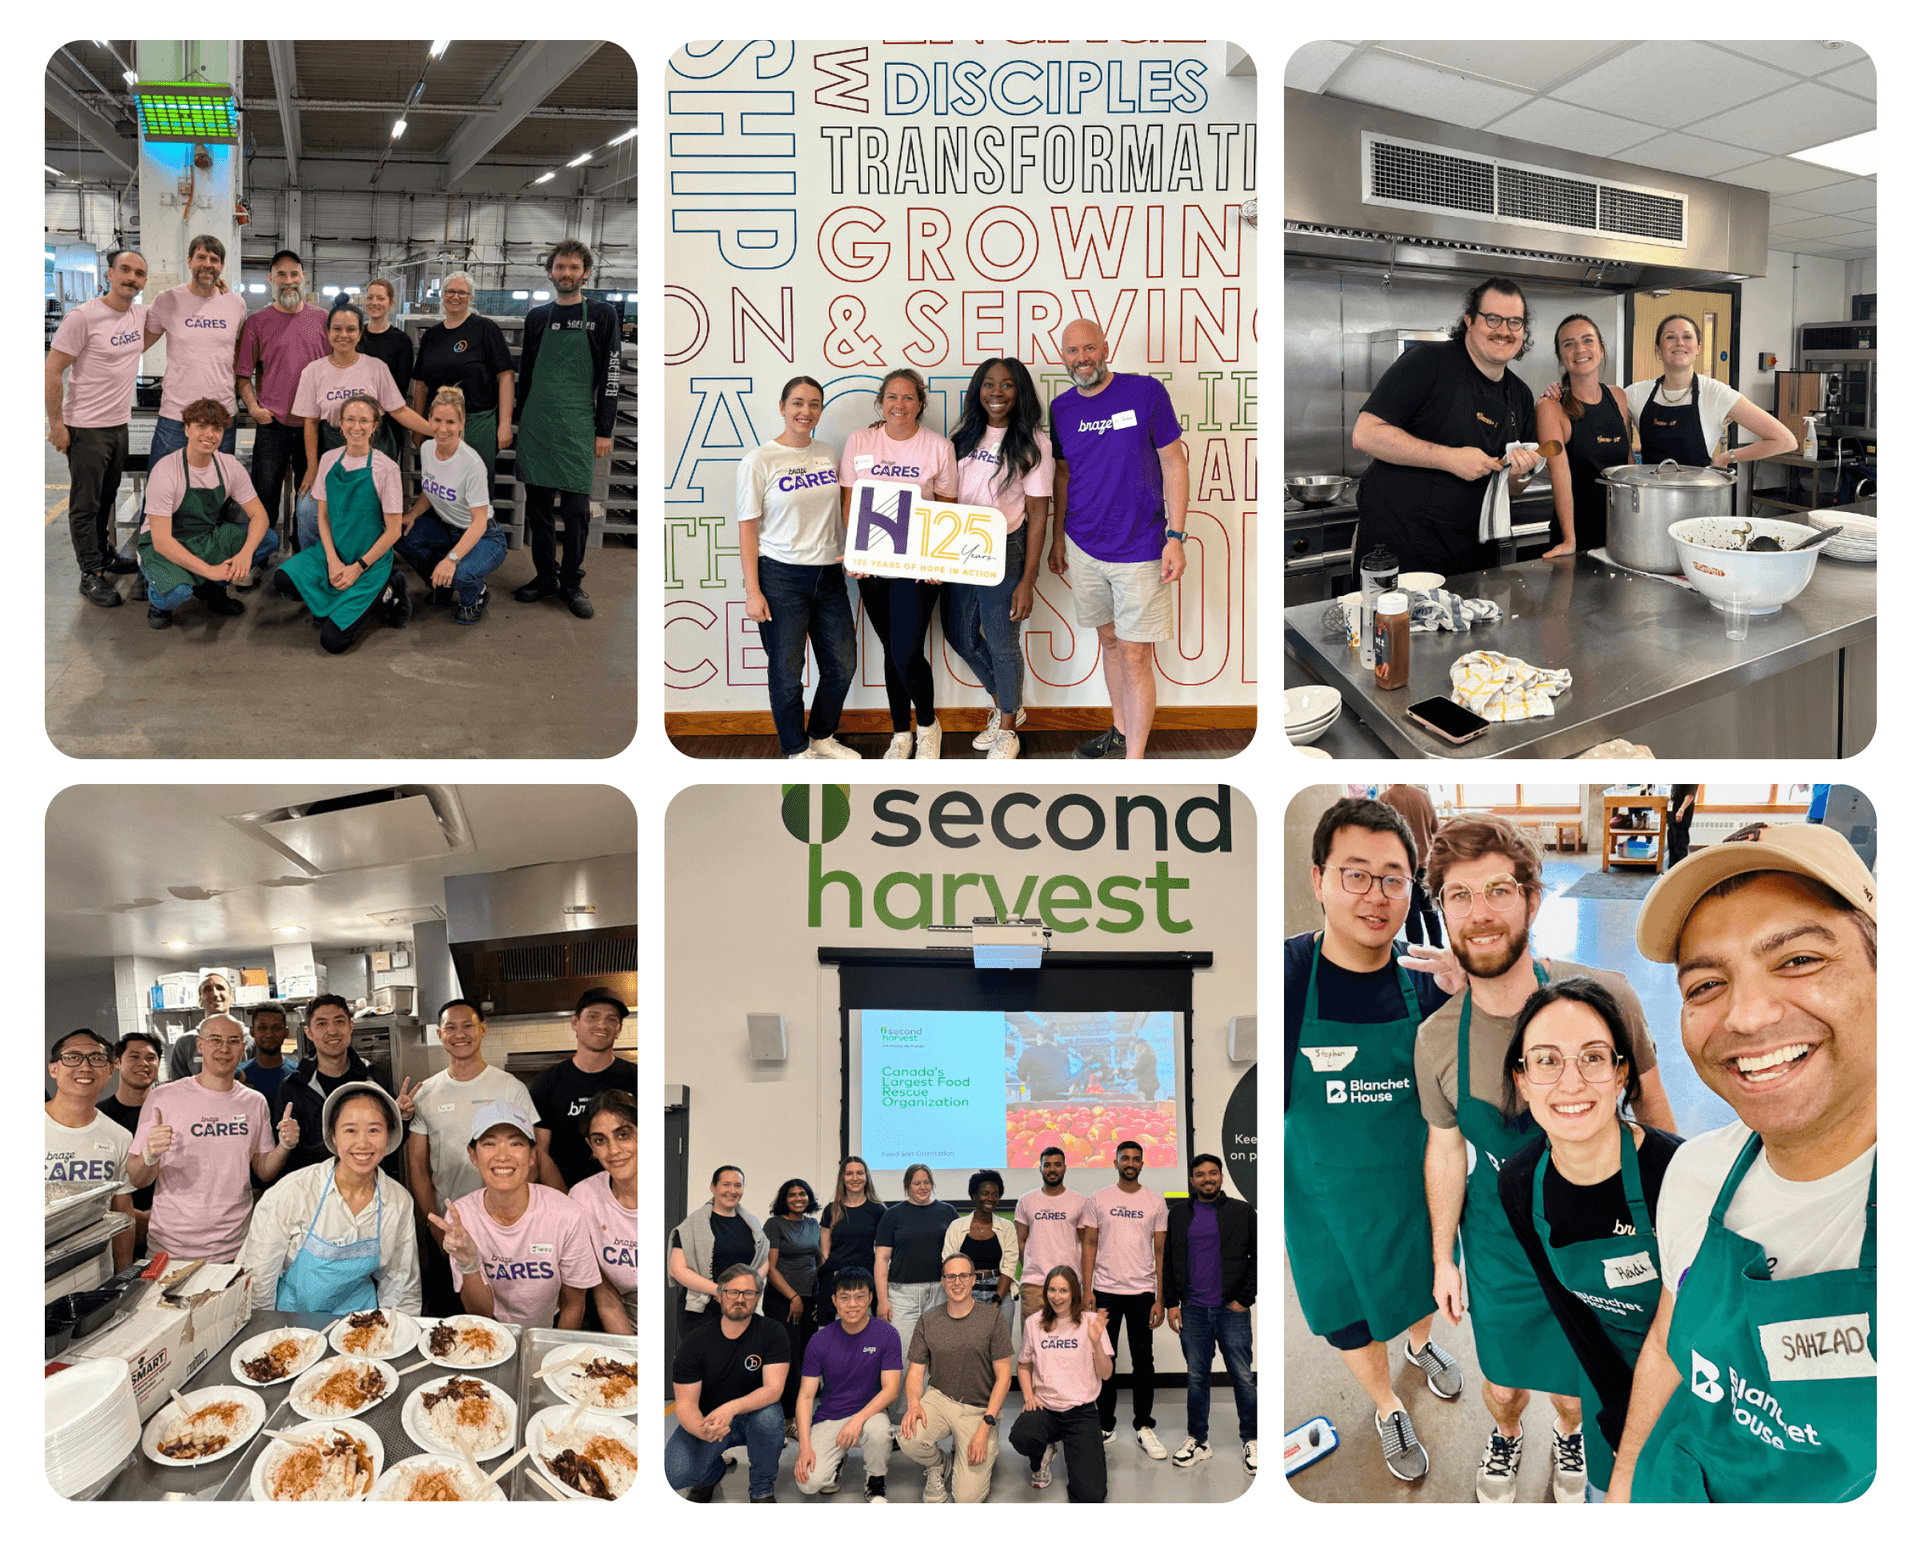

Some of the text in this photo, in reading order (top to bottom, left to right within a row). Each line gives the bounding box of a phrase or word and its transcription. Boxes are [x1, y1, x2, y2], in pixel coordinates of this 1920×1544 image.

[884, 59, 1209, 116] DISCIPLES
[820, 123, 1257, 195] TRANSFORMATI
[817, 205, 1241, 282] GROWIN
[185, 318, 227, 329] CARES
[823, 288, 1257, 368] & SERVIN
[110, 331, 141, 346] CARES
[1078, 419, 1112, 435] braze
[870, 464, 920, 478] CARES
[778, 469, 838, 492] CARES
[421, 478, 457, 501] ARES
[915, 507, 993, 560] 125
[853, 558, 997, 579] 125 YEARS OF HOPE IN ACTION
[870, 784, 1233, 854] second
[807, 843, 1194, 934] harvest
[882, 1066, 945, 1076] Canada's
[882, 1076, 970, 1088] Largest Food
[1349, 1077, 1410, 1092] Blanchet
[882, 1087, 928, 1097] Rescue
[1350, 1092, 1393, 1103] House
[882, 1096, 969, 1109] Organization
[190, 1122, 249, 1137] CARES
[45, 1151, 75, 1163] braze
[1230, 1152, 1246, 1160] on
[45, 1160, 115, 1181] ARES
[1034, 1211, 1067, 1221] CARES
[1110, 1208, 1144, 1219] CARES
[484, 1261, 554, 1280] CARES
[1041, 1338, 1079, 1350] CARES
[1781, 1326, 1865, 1362] SAHZAD
